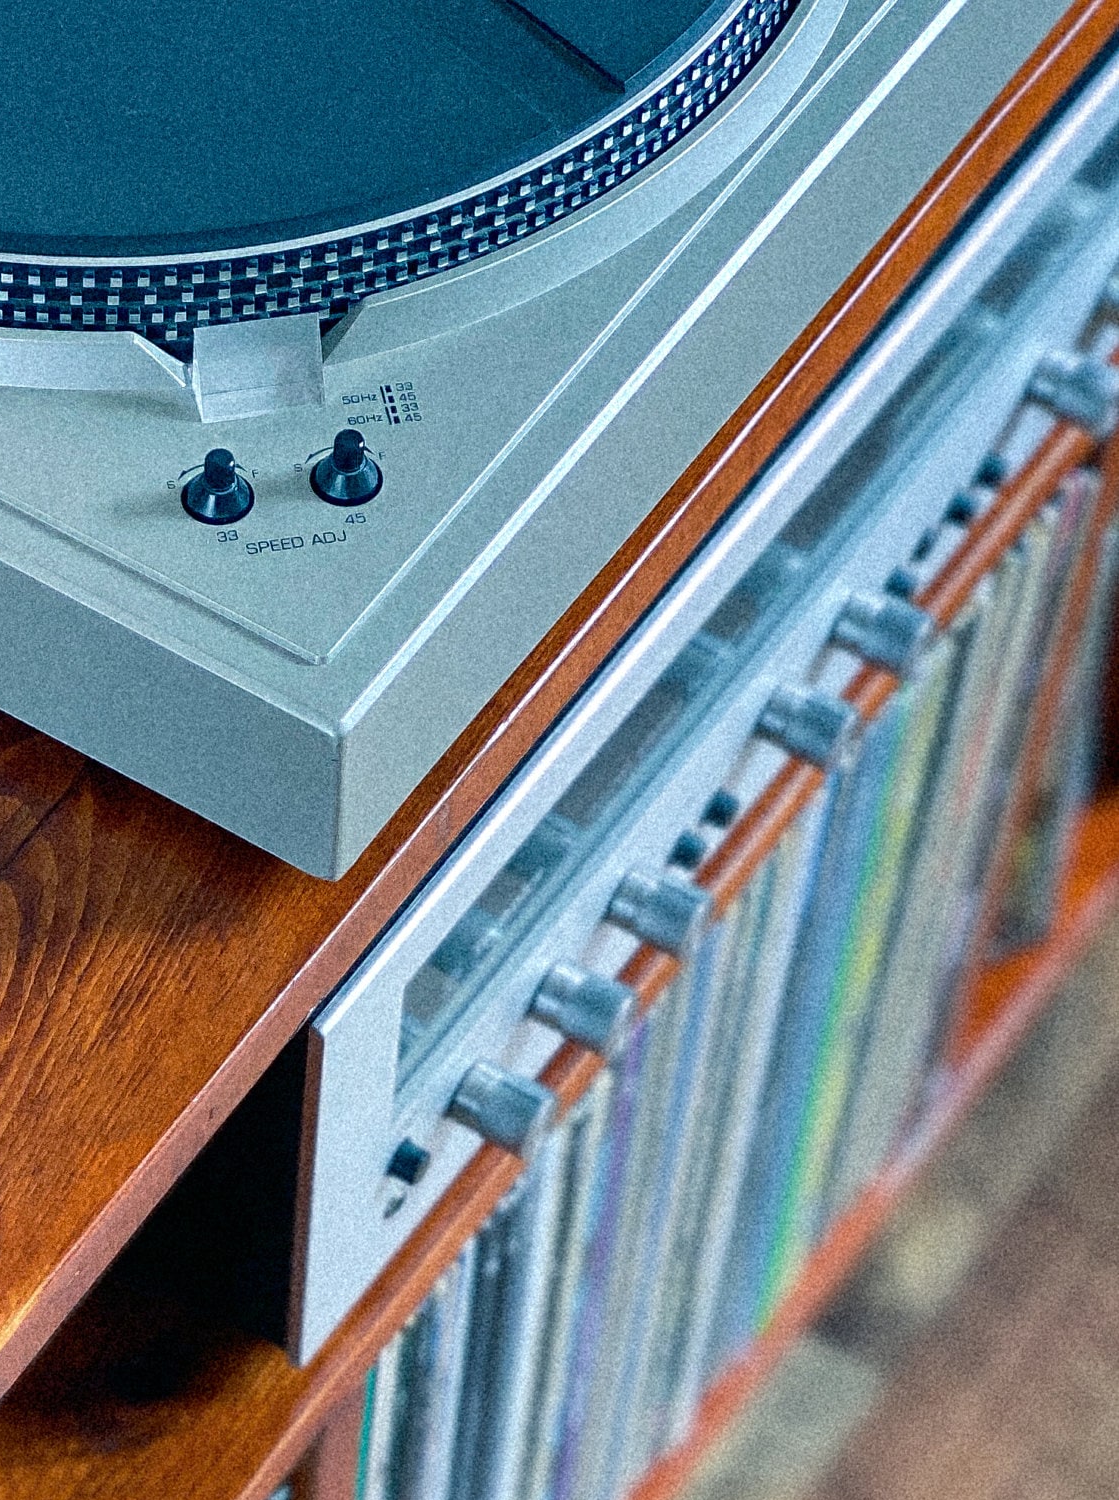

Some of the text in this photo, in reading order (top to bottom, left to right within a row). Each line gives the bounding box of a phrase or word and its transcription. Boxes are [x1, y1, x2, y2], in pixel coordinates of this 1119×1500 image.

[395, 381, 413, 392] 33
[341, 393, 378, 405] 50Hz
[399, 391, 417, 402] 45
[400, 402, 419, 413] 33
[347, 414, 383, 426] 60Hz
[404, 412, 422, 422] 45
[251, 468, 259, 478] F
[293, 463, 303, 473] S
[166, 480, 176, 490] S
[344, 512, 367, 525] 45
[216, 529, 239, 543] 33
[245, 529, 347, 555] SPEED ADJ
